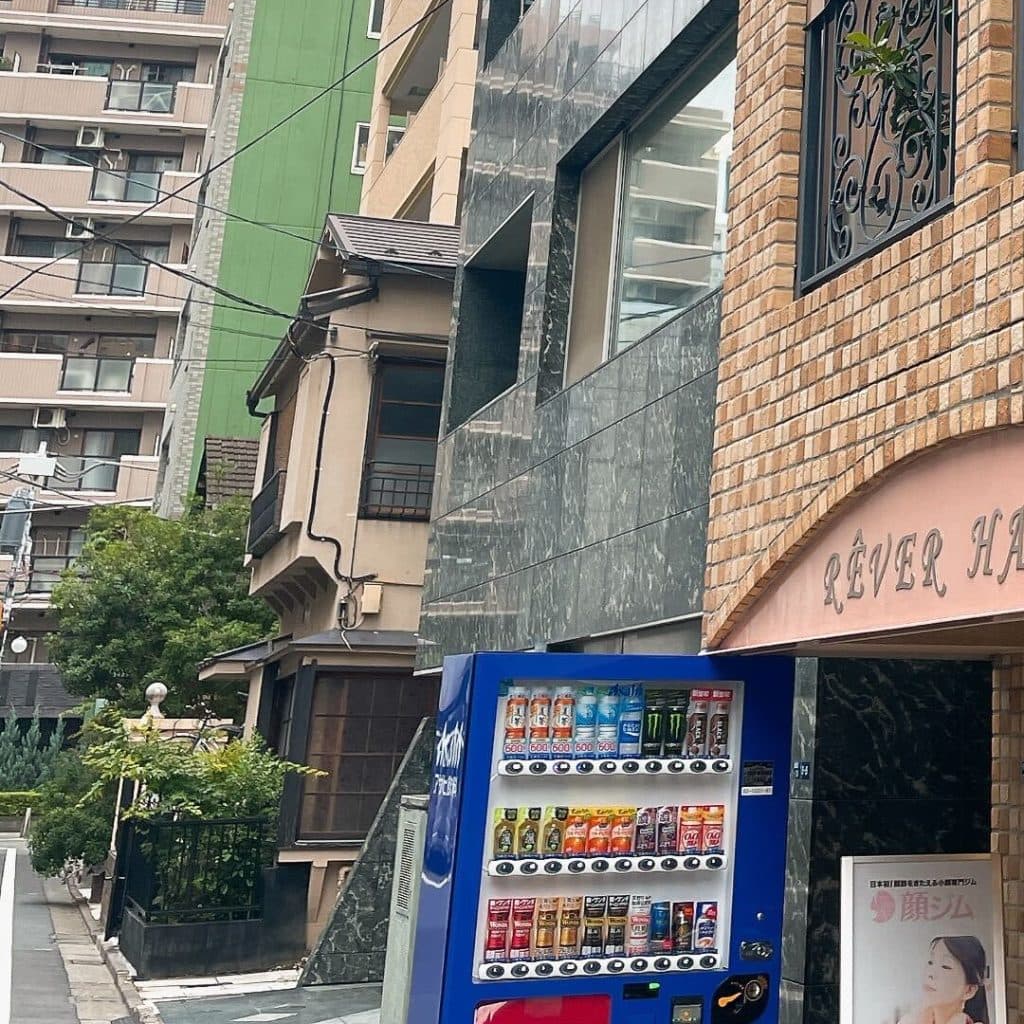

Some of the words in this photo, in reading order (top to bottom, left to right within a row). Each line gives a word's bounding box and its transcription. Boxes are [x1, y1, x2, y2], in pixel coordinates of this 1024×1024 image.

[824, 528, 947, 614] RÊVER
[901, 890, 975, 921] 顔ジム
